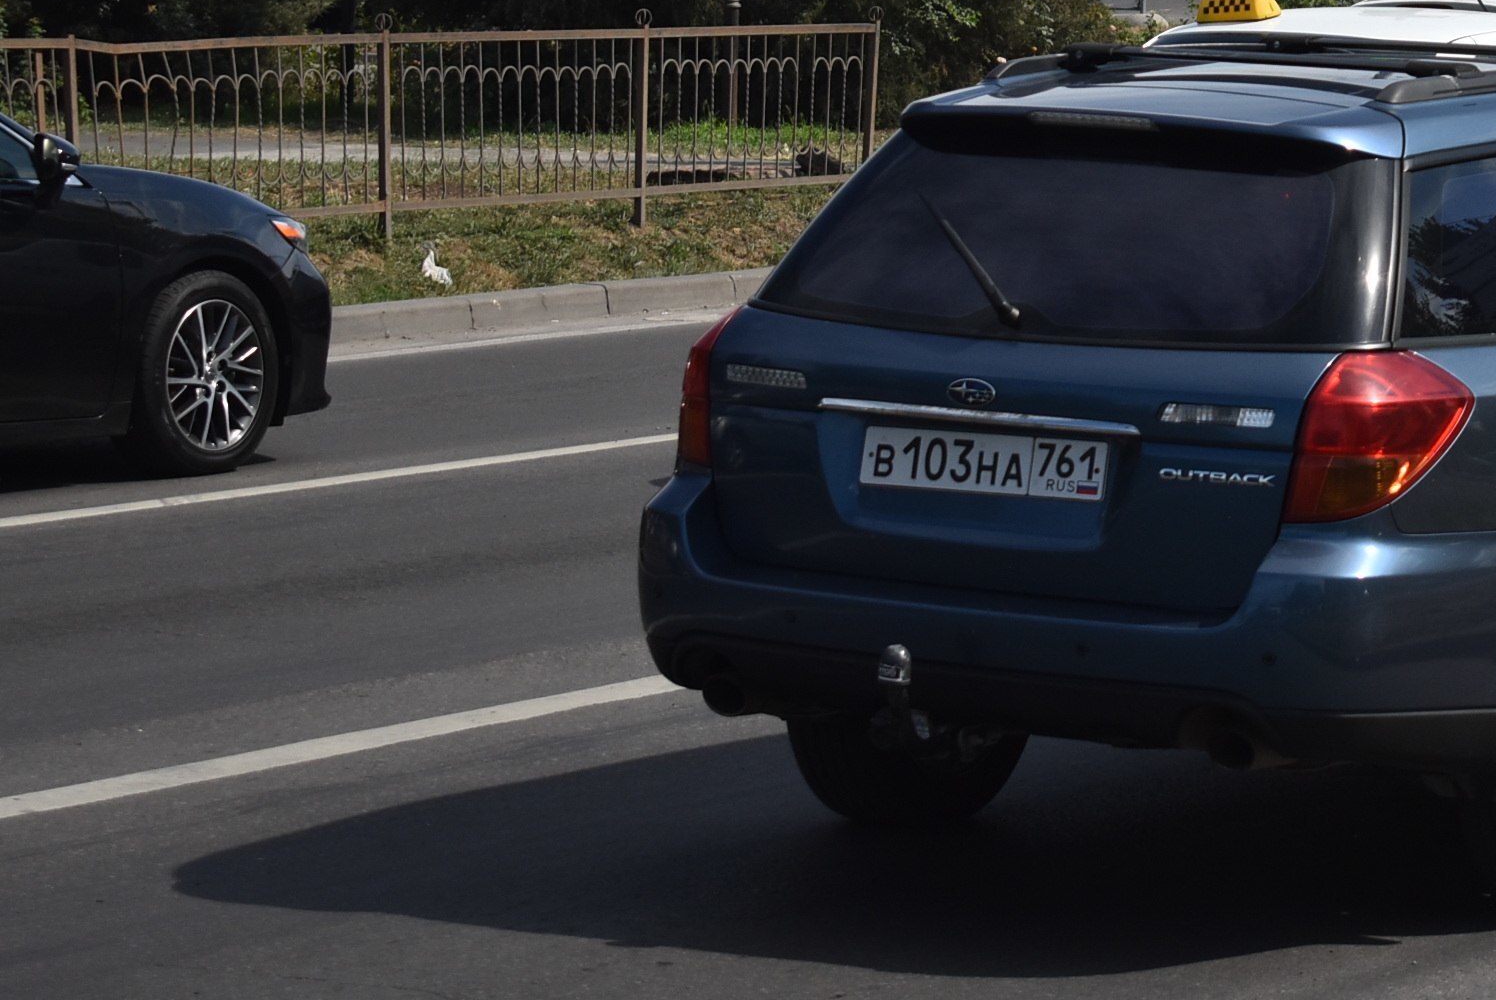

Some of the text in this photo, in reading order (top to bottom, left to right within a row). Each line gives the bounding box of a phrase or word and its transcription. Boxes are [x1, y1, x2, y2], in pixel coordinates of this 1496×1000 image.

[1037, 442, 1098, 481] 761
[1046, 478, 1076, 493] RUS
[1159, 467, 1276, 487] OUTBACK
